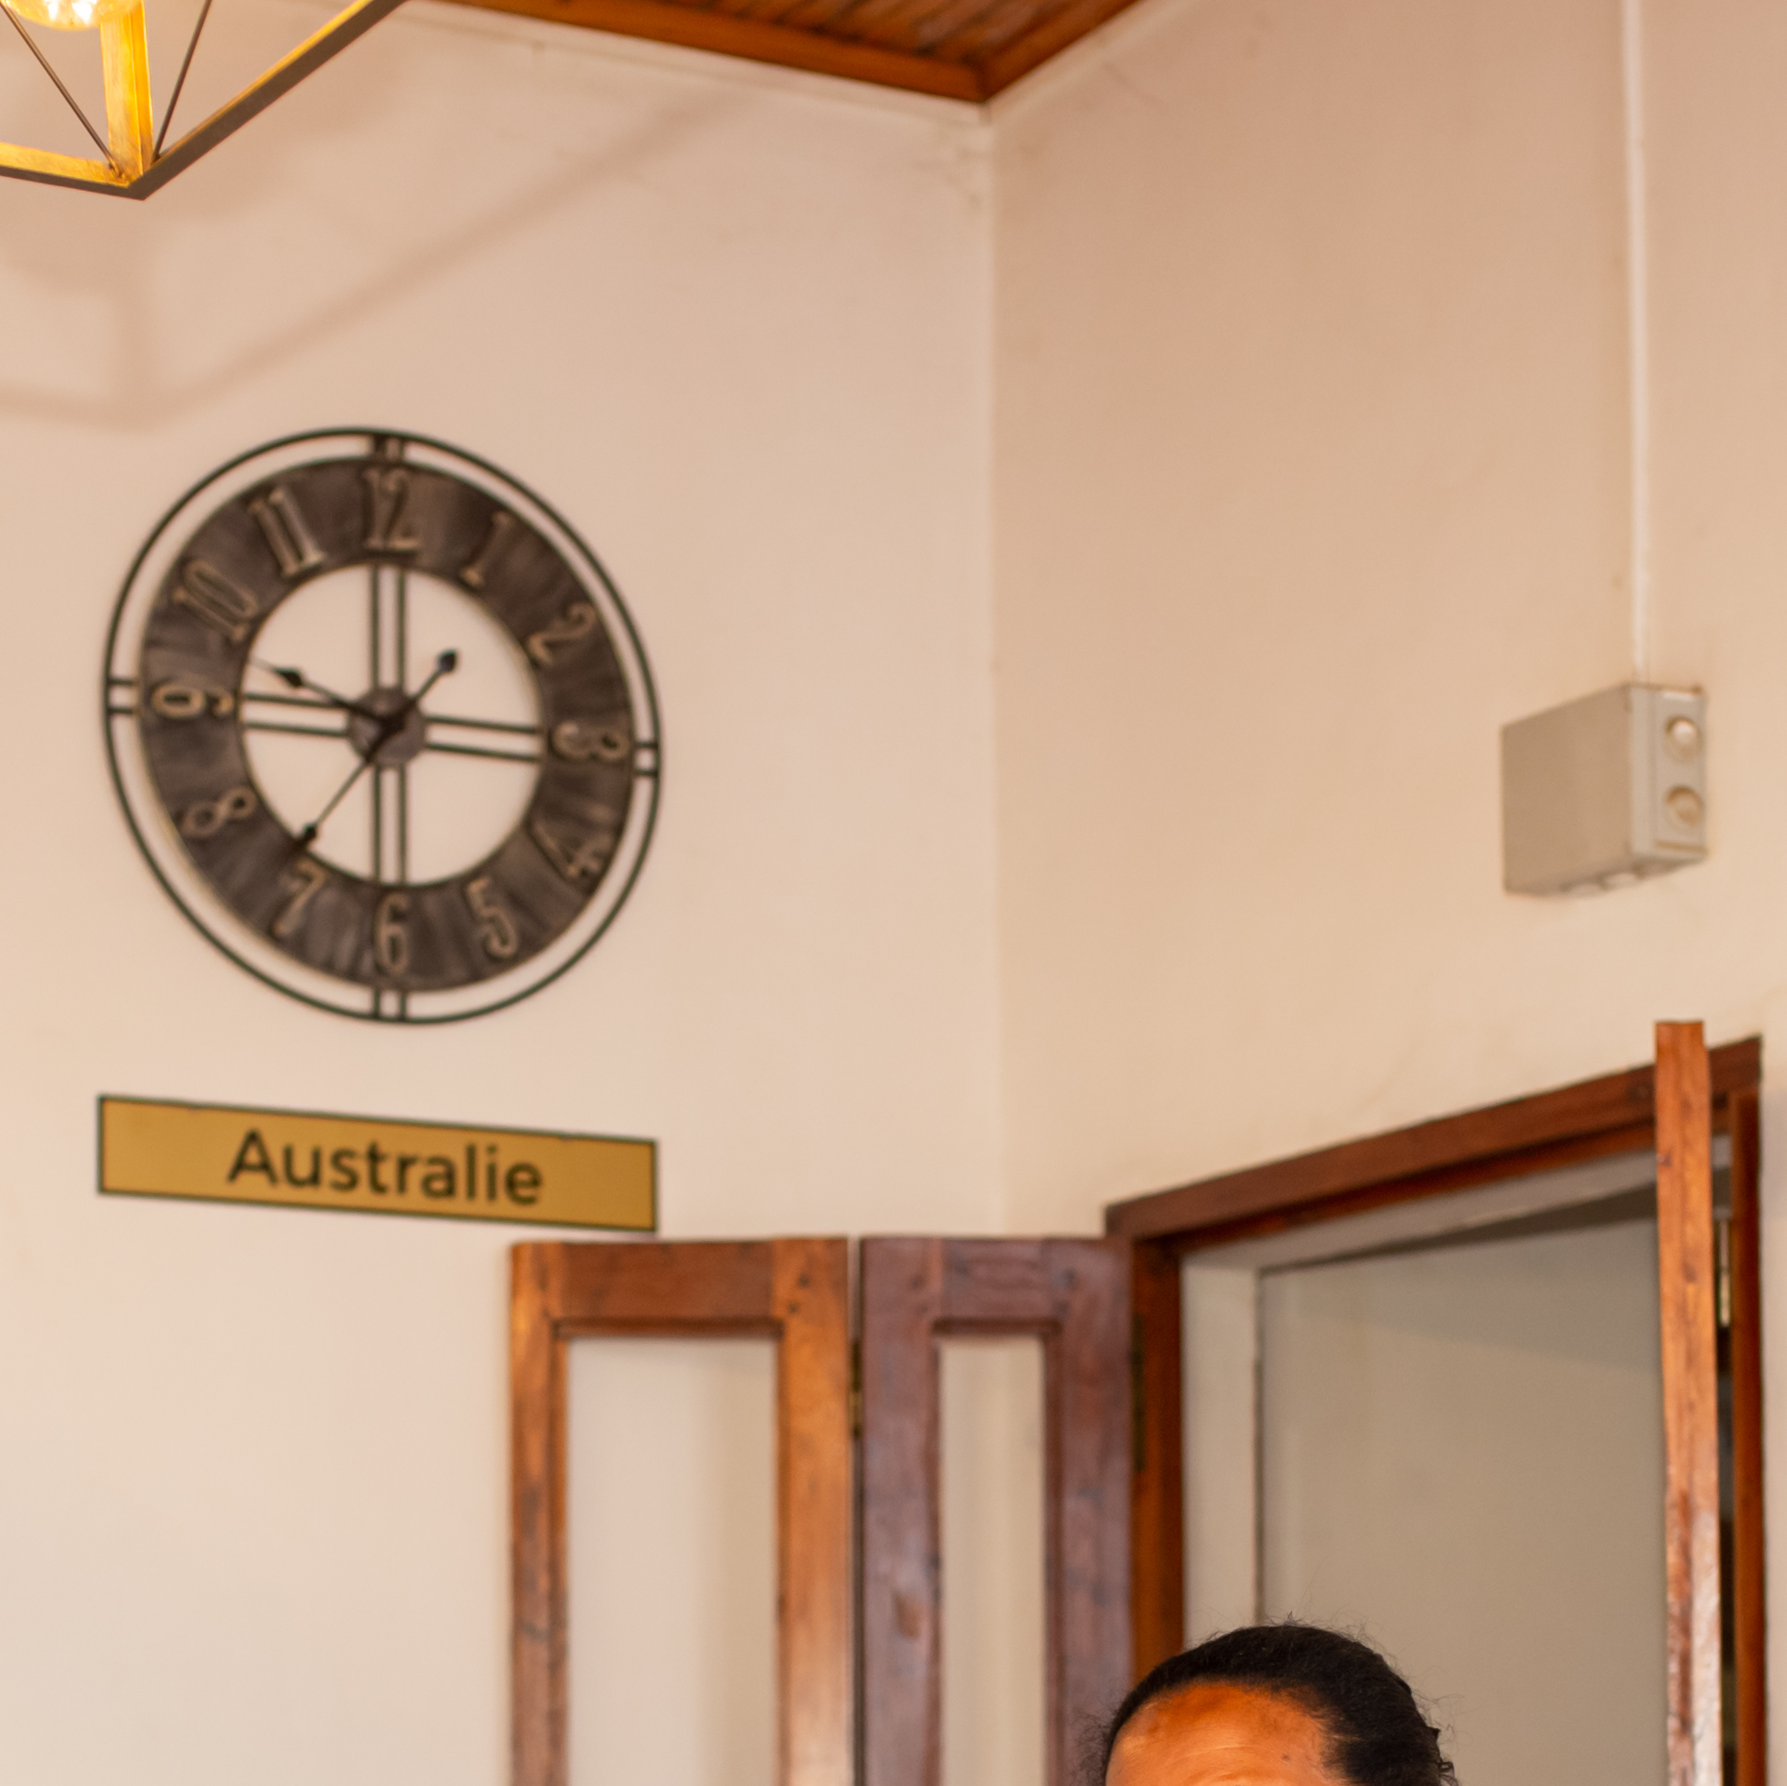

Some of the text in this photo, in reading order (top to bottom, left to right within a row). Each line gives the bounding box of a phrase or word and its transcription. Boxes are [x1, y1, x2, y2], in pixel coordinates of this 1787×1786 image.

[247, 486, 328, 578] 11
[363, 466, 423, 553] 12
[459, 510, 513, 586] 1
[171, 558, 260, 642] 10
[528, 603, 597, 666] 2
[150, 683, 234, 720] 9
[548, 721, 630, 760] 3
[179, 786, 258, 839] 8
[529, 820, 612, 881] 4
[272, 859, 330, 939] 7
[373, 893, 412, 977] 6
[466, 877, 518, 959] 5
[227, 1129, 544, 1206] Australie
